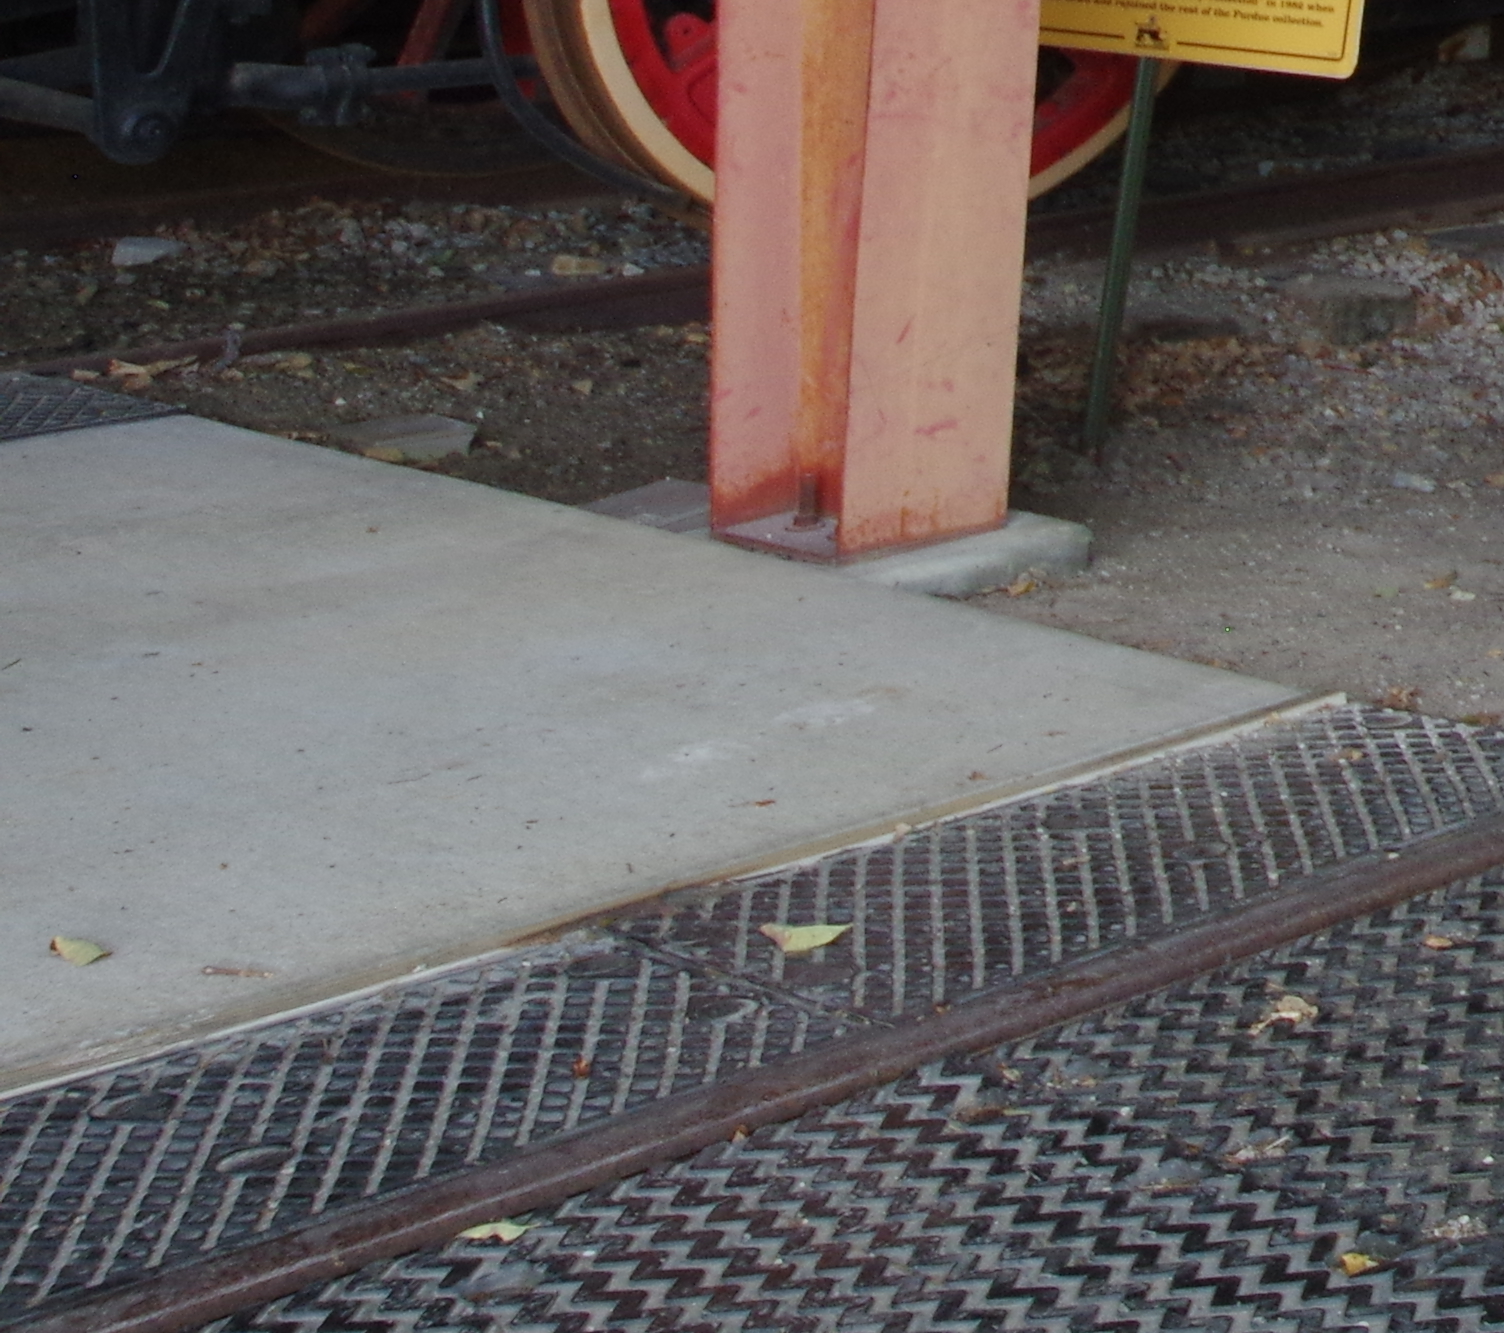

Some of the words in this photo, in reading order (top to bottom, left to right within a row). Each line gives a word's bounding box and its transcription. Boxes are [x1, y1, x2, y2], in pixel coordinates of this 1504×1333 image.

[1160, 2, 1175, 11] the
[1179, 4, 1198, 14] rest
[1202, 6, 1211, 15] of
[1214, 8, 1230, 17] the
[1233, 10, 1270, 21] Purdue
[1308, 2, 1335, 12] when
